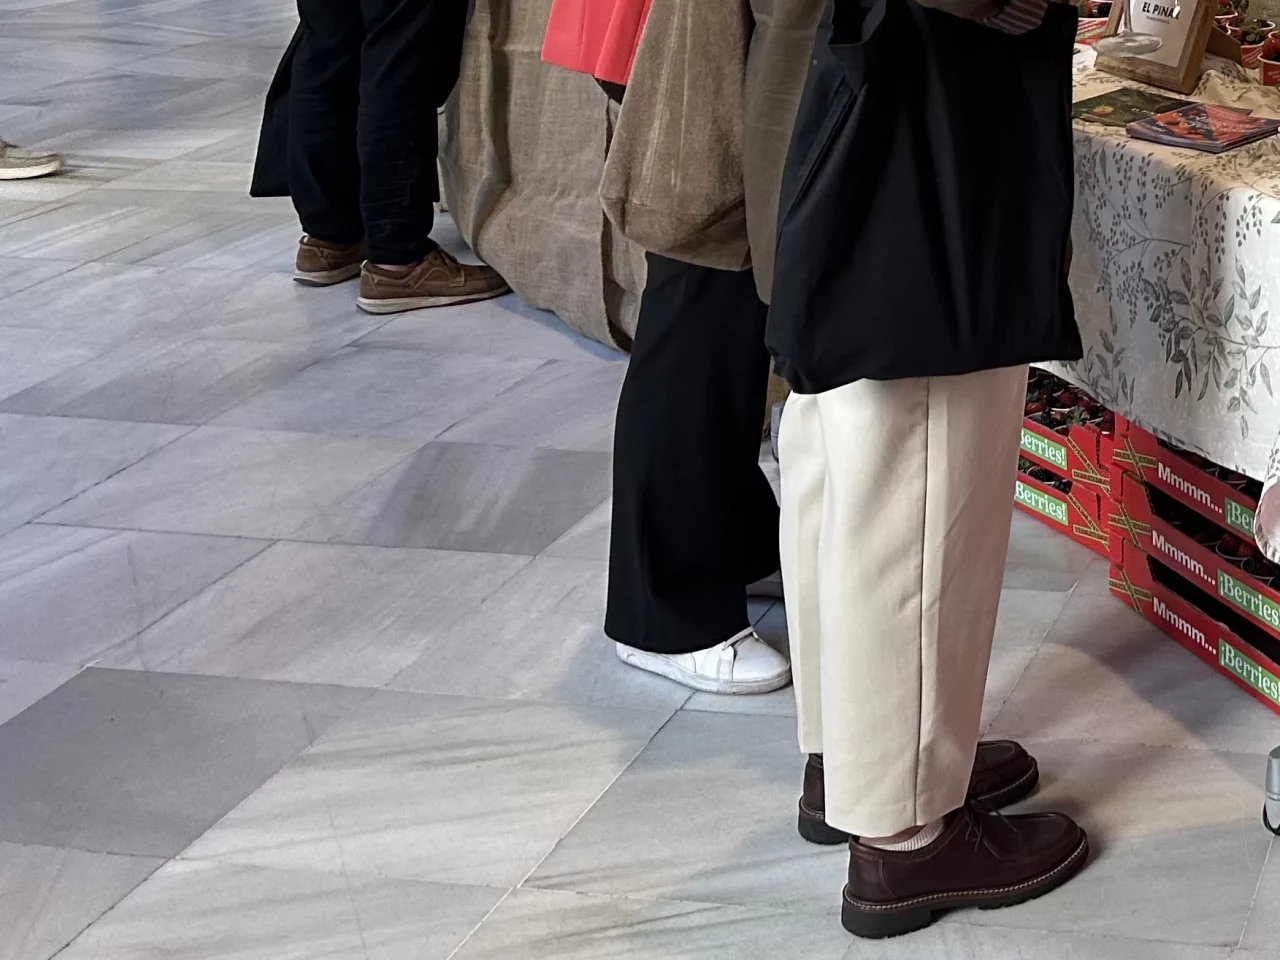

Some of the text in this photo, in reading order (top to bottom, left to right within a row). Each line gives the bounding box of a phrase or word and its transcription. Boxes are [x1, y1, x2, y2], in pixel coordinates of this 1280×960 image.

[1141, 1, 1151, 13] EL
[1152, 530, 1216, 586] Mmmm...
[1153, 596, 1217, 655] Mmmm...
